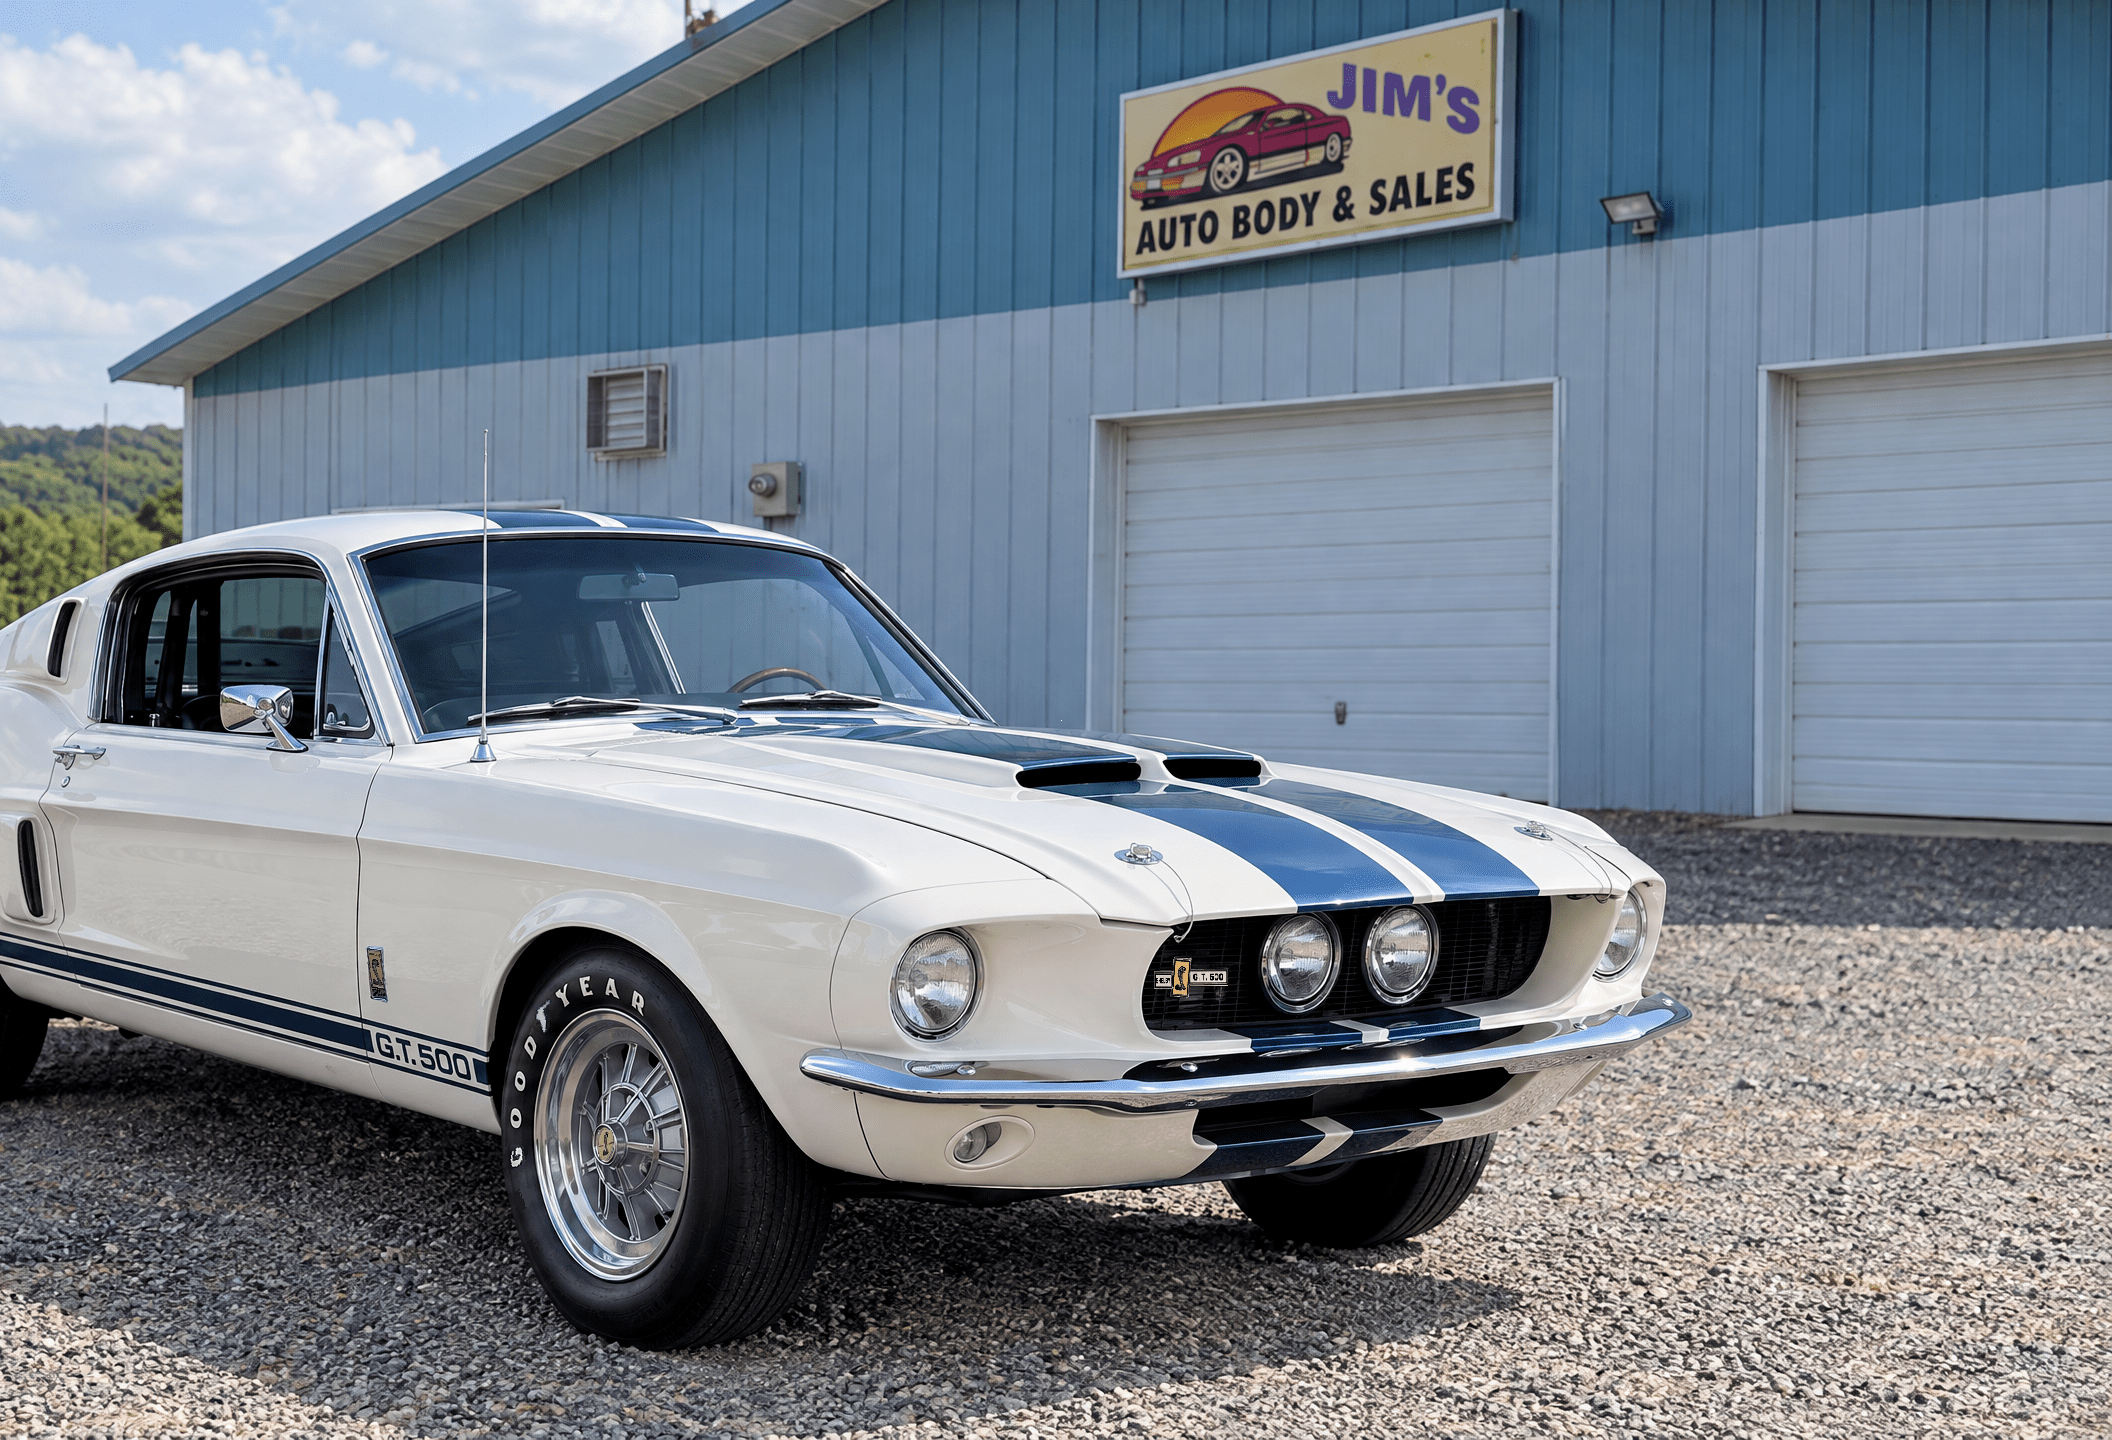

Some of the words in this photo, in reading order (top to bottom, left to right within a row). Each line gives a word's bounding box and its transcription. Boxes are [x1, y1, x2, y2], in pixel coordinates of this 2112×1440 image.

[1327, 63, 1480, 134] JIM'S
[1136, 210, 1219, 255] AUTO
[1232, 191, 1321, 239] BODY
[1332, 185, 1355, 222] &
[1369, 162, 1475, 215] SALES
